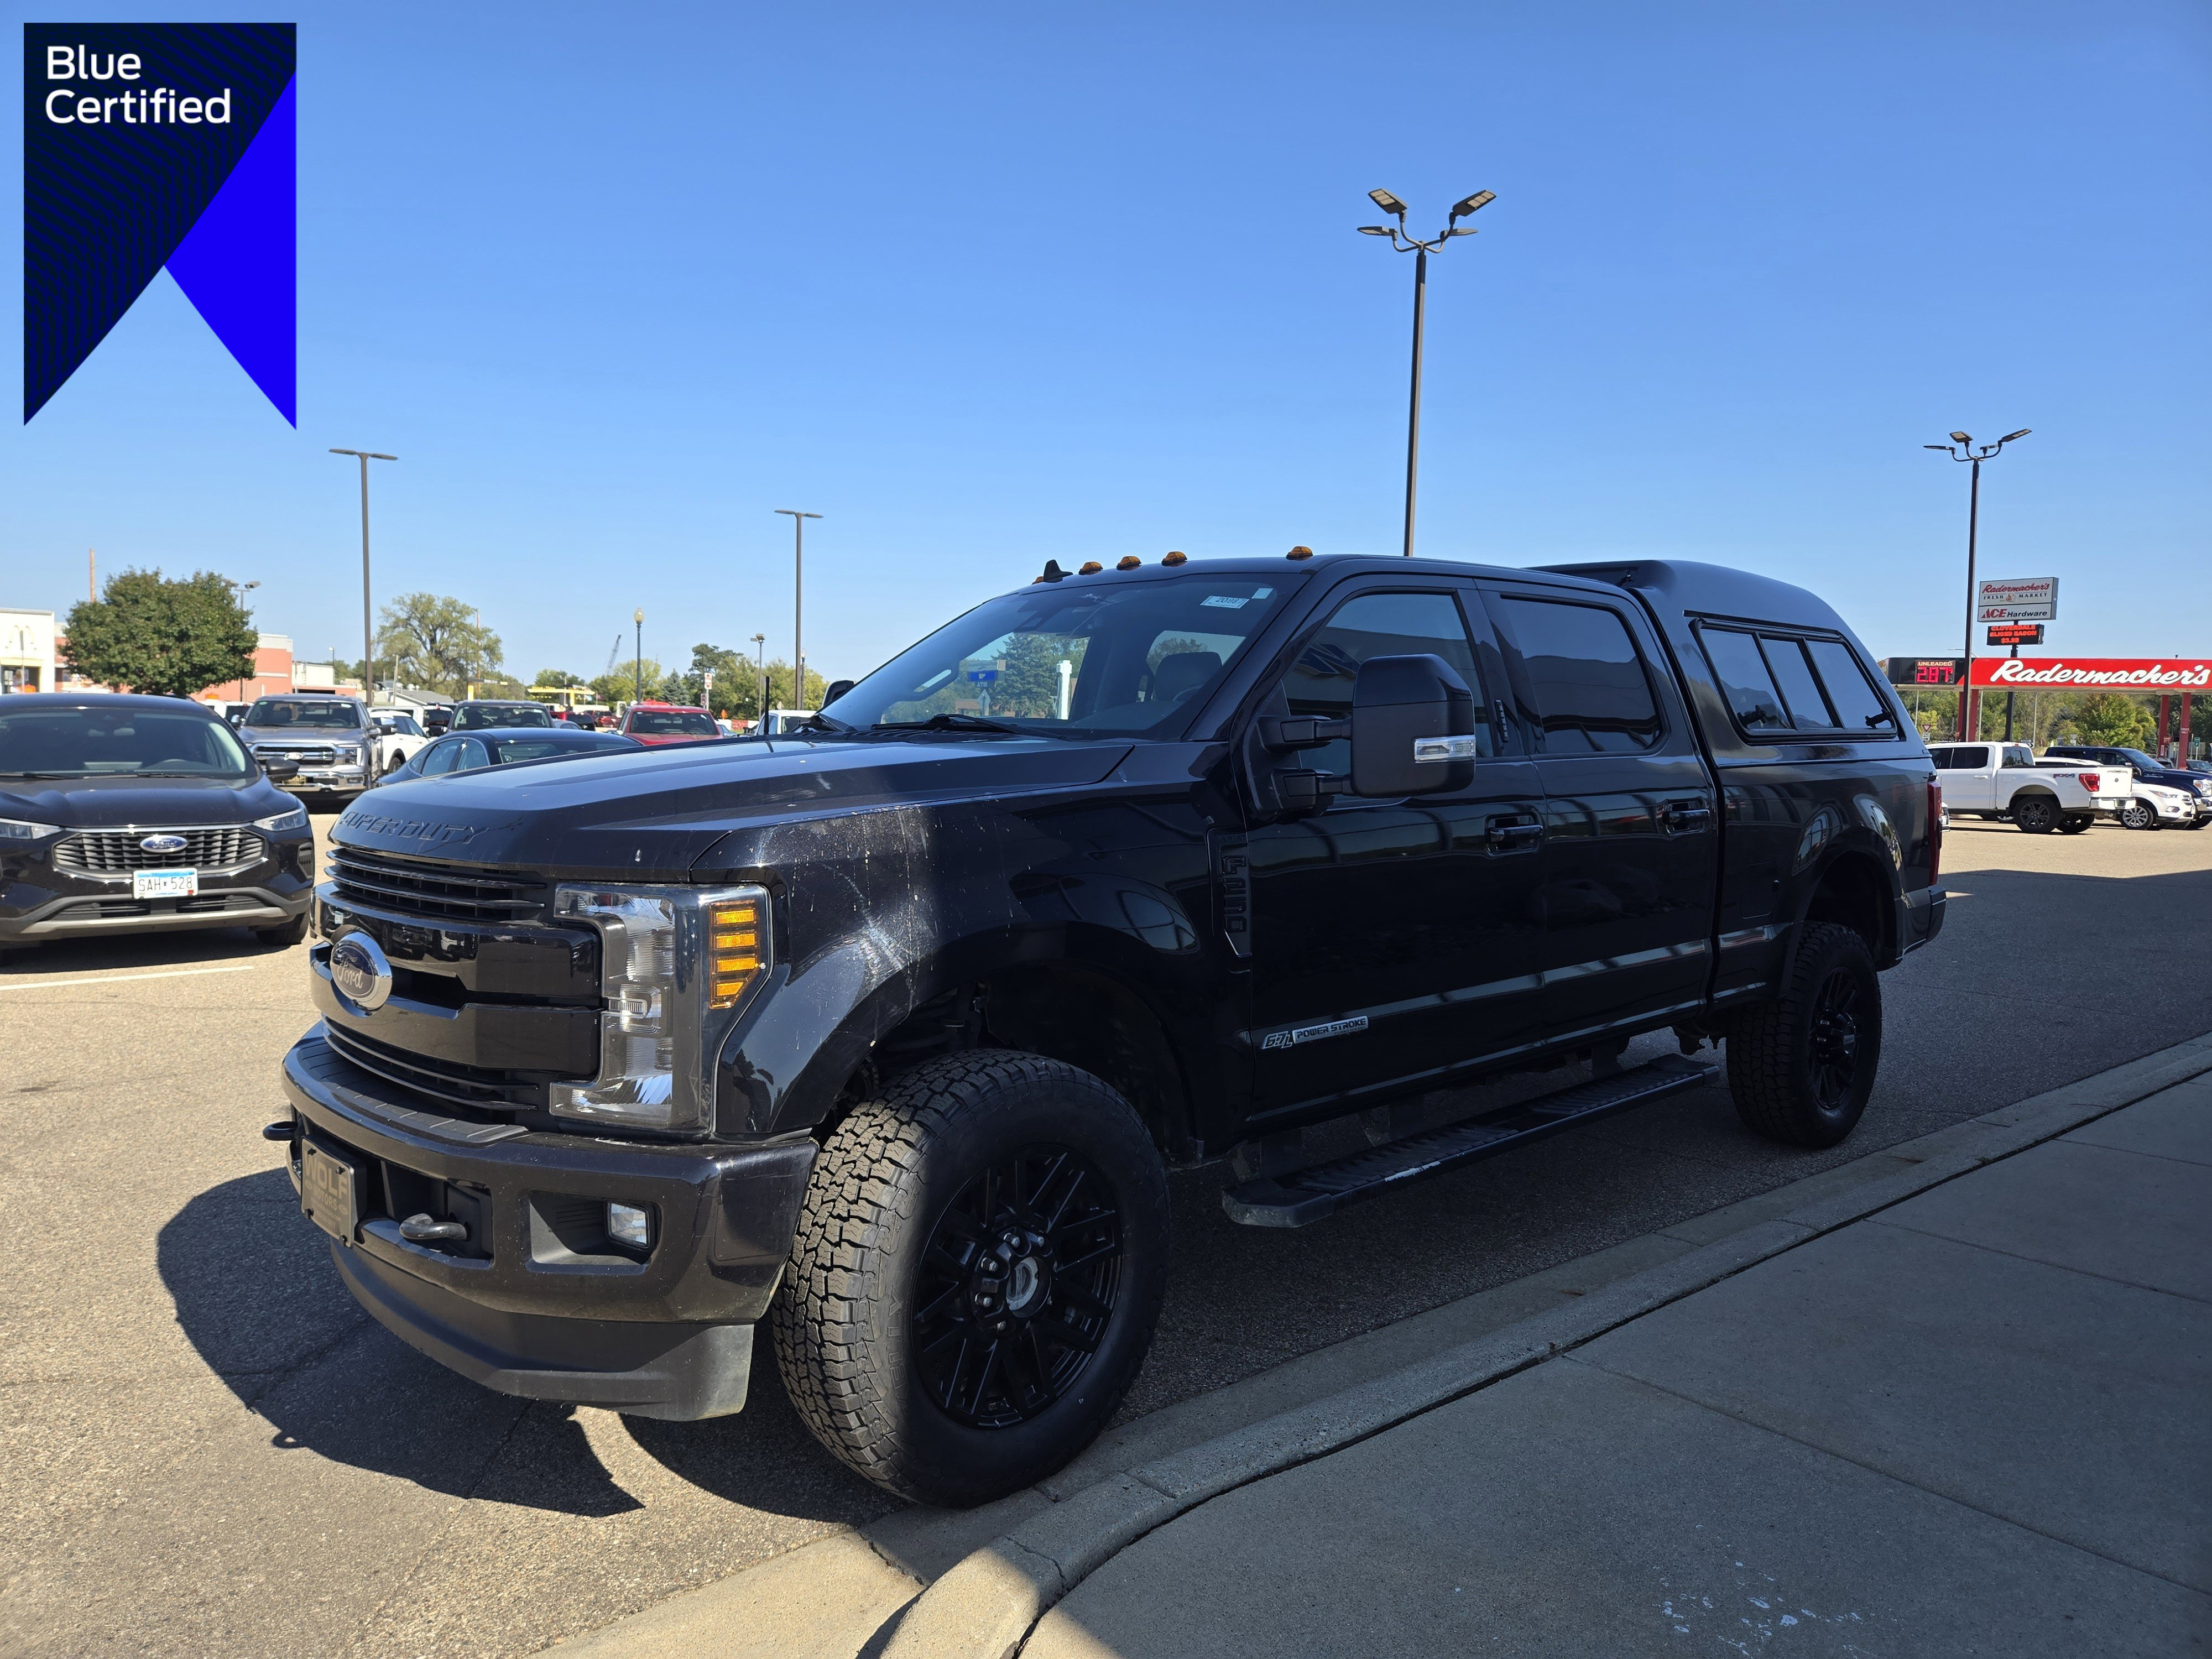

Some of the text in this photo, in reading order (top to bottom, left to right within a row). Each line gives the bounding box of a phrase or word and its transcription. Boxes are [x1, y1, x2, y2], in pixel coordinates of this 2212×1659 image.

[1982, 583, 2050, 593] Radermacher's
[1981, 608, 2007, 619] ACE
[1990, 660, 2211, 686] Radermacher's
[340, 811, 489, 844] SUPER DUTY
[138, 877, 192, 891] SAH 528
[336, 951, 364, 989] Ford
[1296, 1026, 1329, 1040] POWER
[1331, 1018, 1366, 1032] STROKE
[304, 1150, 348, 1200] WOLF
[314, 1185, 338, 1212] MOTORS
